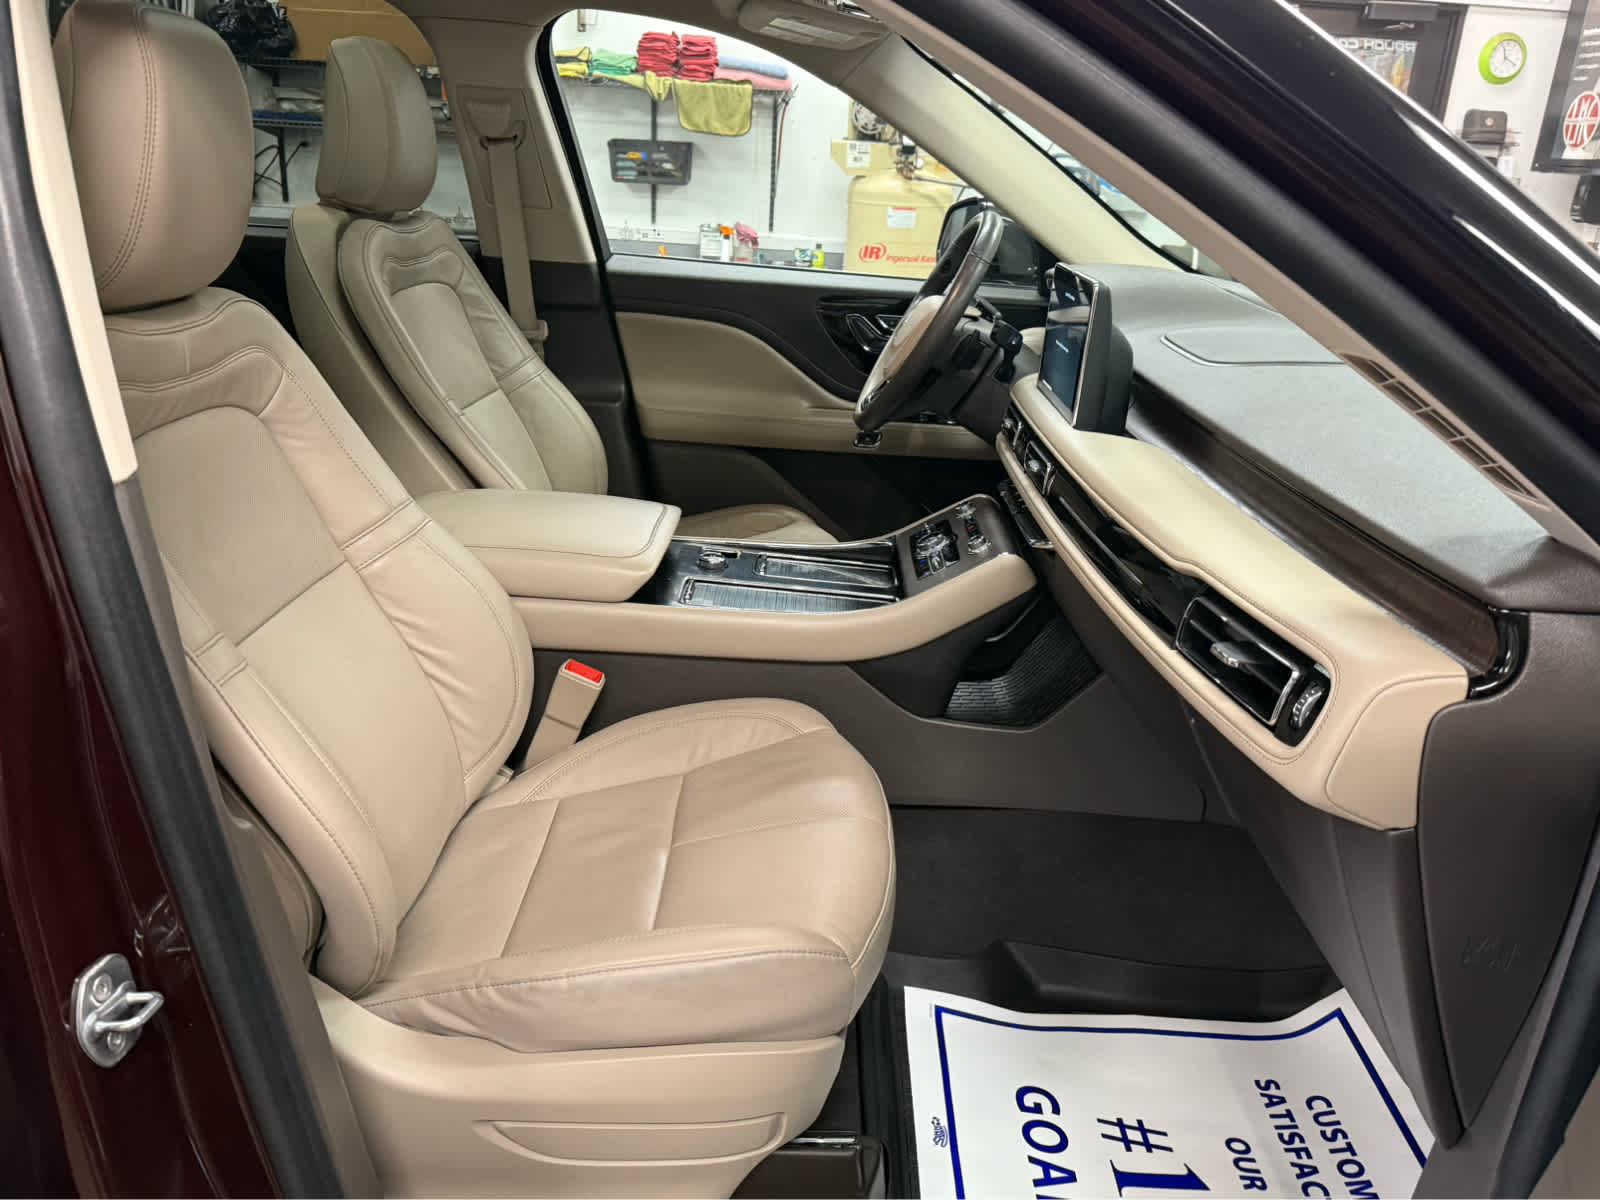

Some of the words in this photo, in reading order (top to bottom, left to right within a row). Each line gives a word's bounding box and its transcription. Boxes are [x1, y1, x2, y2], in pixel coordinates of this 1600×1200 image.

[861, 244, 883, 261] IR
[1015, 1085, 1078, 1200] GOA
[1096, 1117, 1210, 1198] #1
[1224, 1137, 1268, 1191] OUR
[1305, 1095, 1380, 1200] CUSTOM
